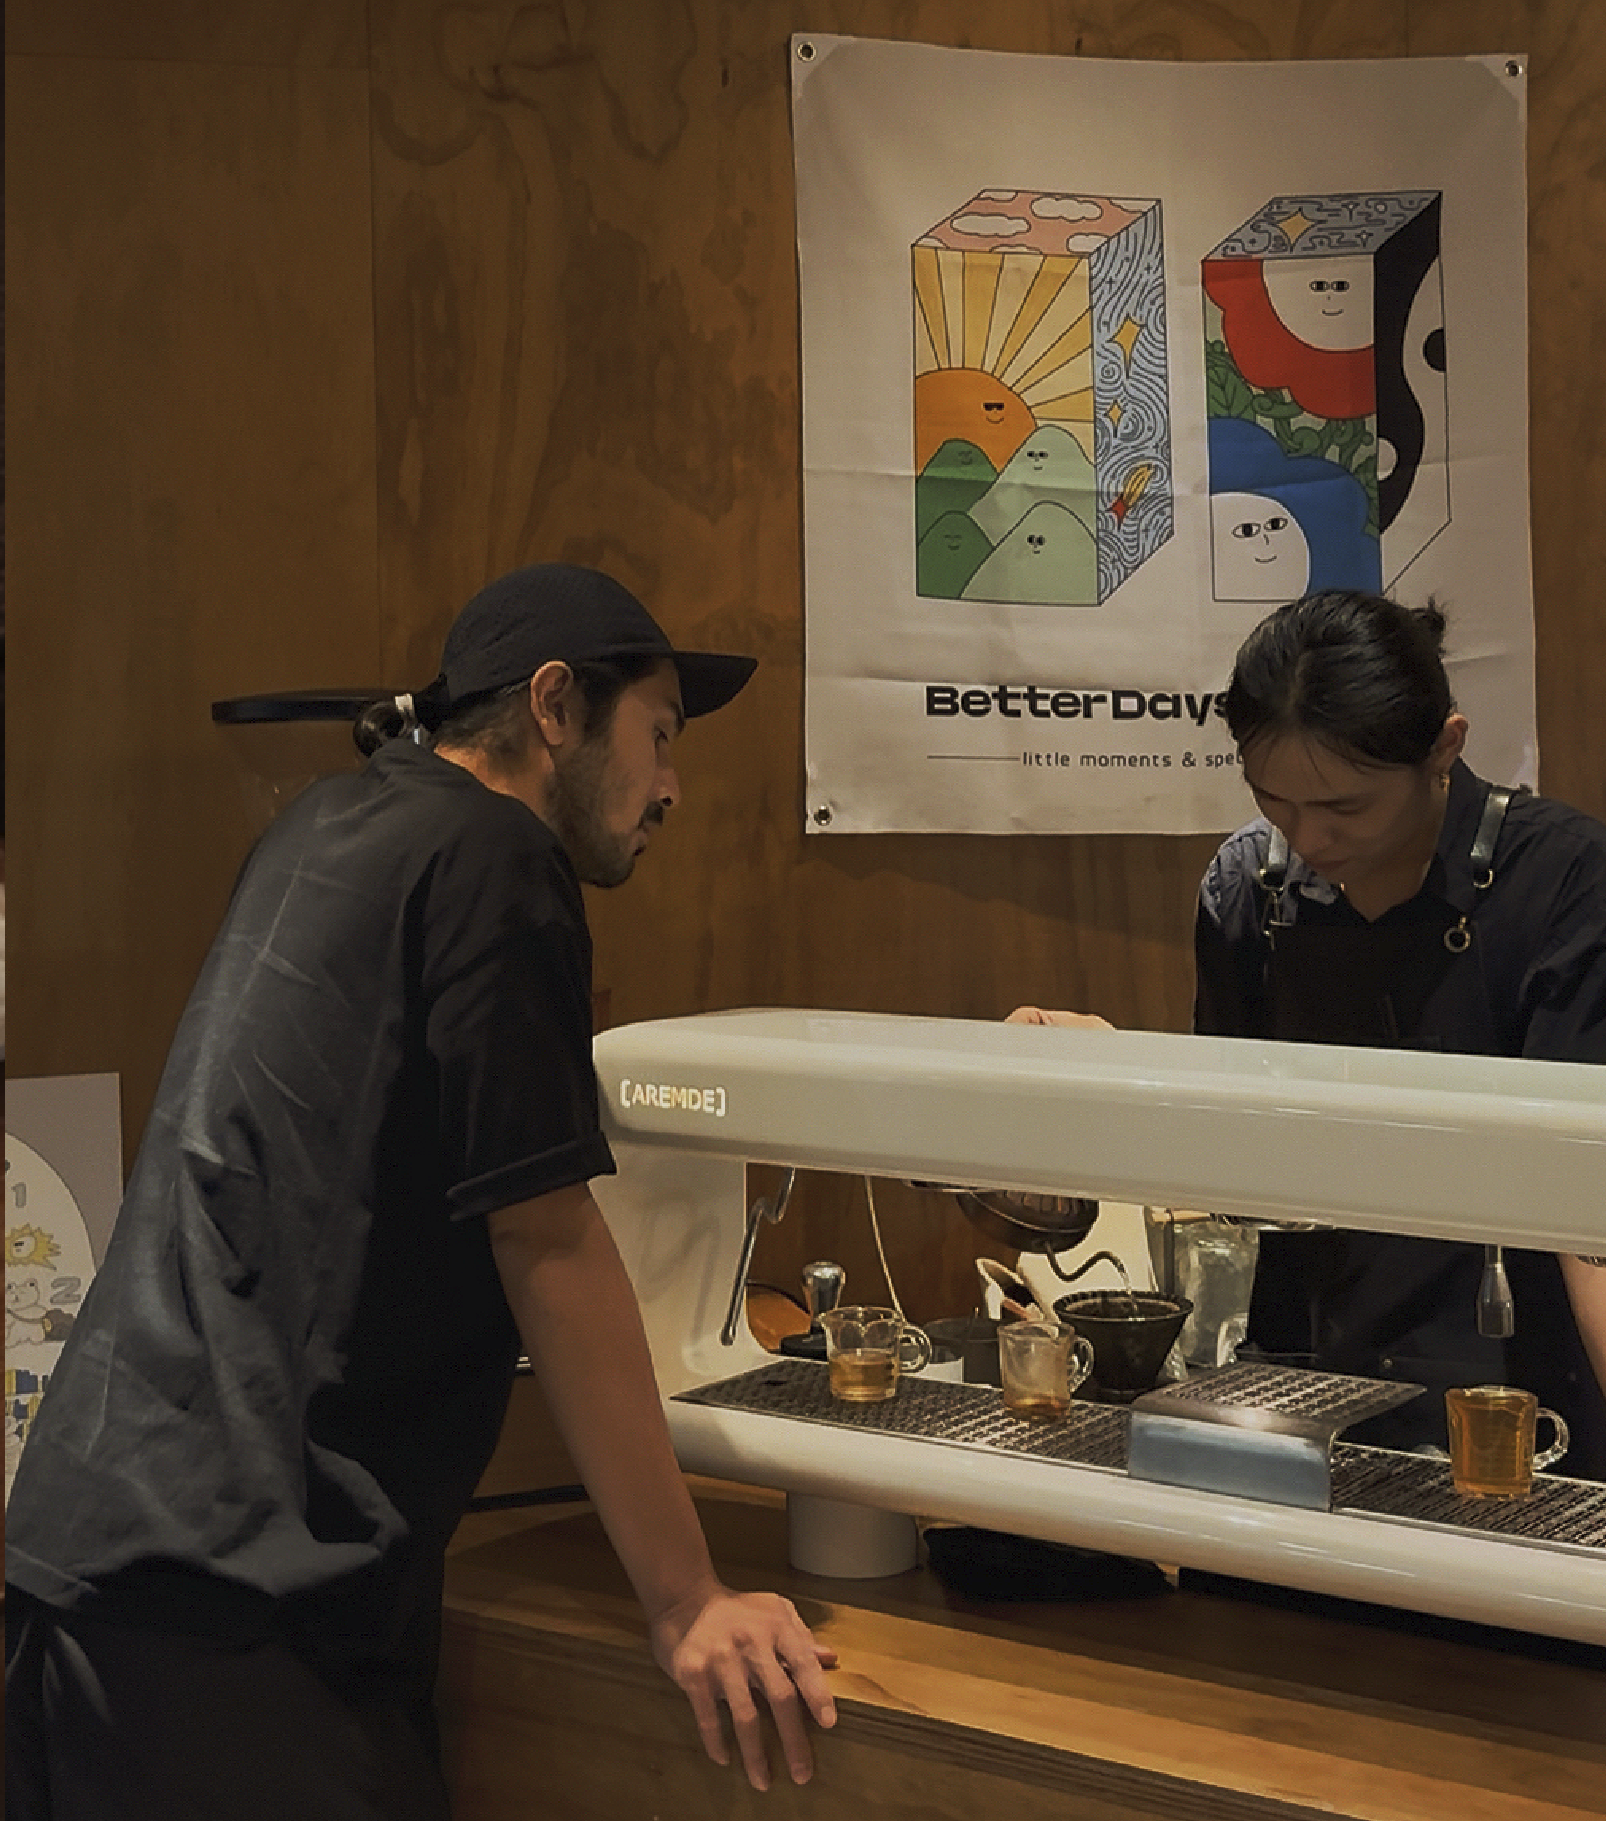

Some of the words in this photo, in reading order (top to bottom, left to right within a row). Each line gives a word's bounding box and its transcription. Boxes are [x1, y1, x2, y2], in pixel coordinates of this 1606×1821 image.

[1023, 752, 1070, 768] little
[1080, 752, 1172, 768] moments
[1182, 751, 1197, 768] &
[11, 1182, 27, 1208] 1
[50, 1276, 81, 1304] 2
